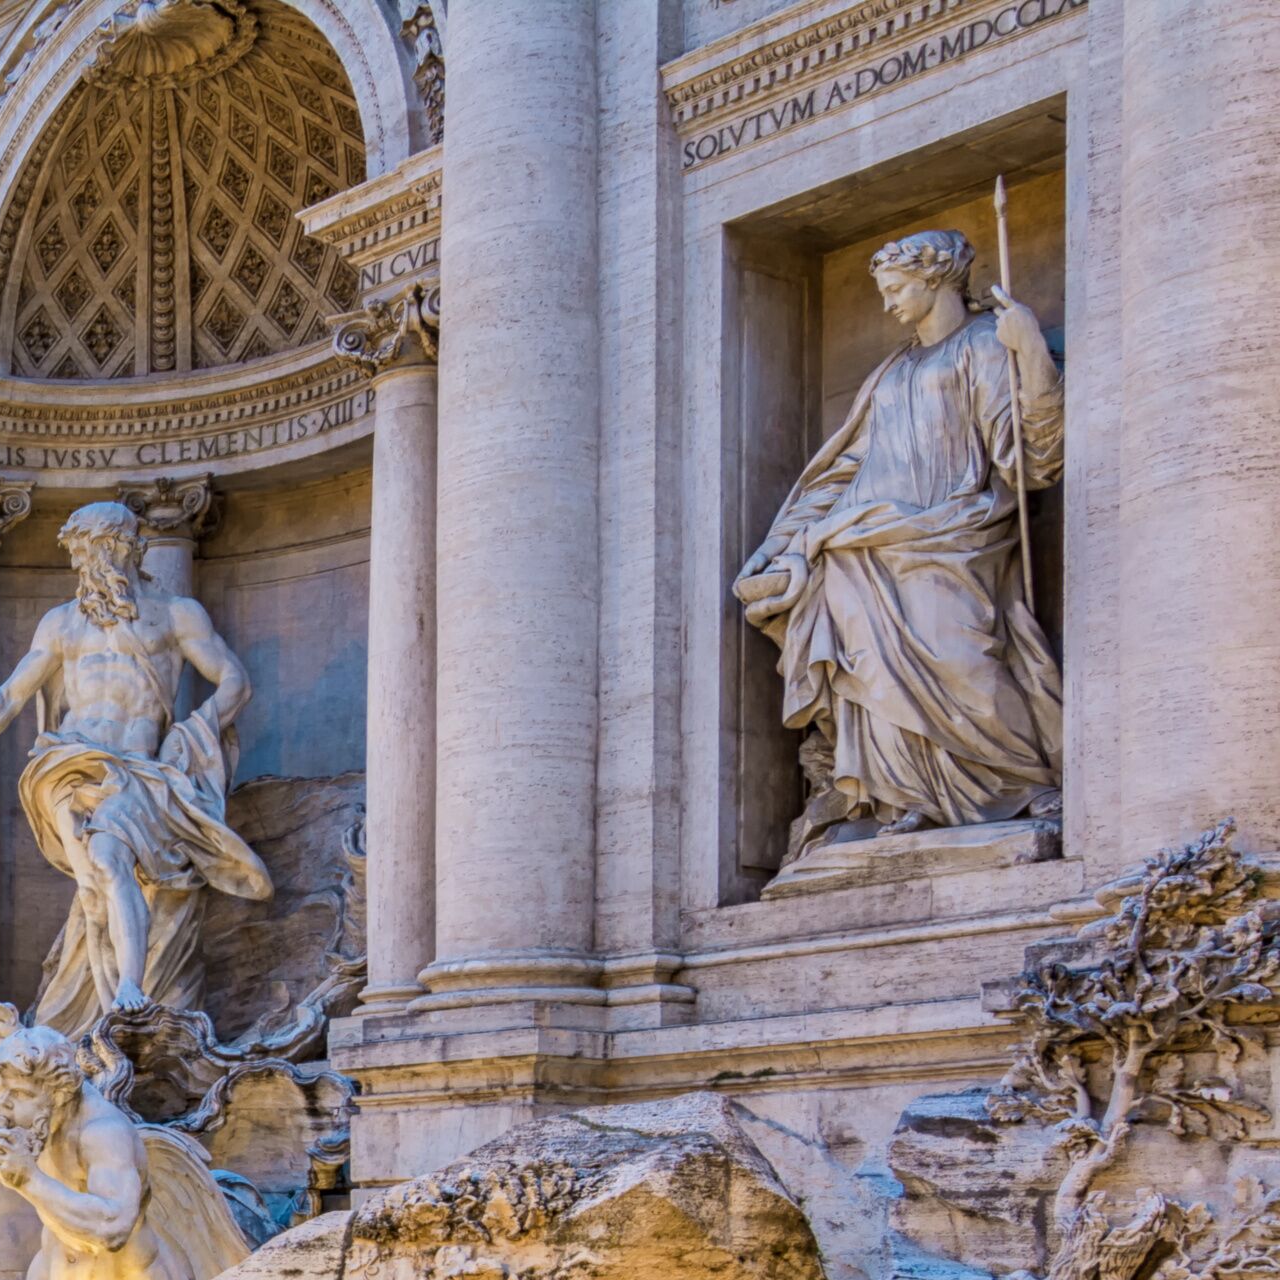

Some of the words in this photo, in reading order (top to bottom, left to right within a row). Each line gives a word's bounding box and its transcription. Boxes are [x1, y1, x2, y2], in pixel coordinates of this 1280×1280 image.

[683, 89, 817, 169] SOLVTVM
[360, 261, 383, 291] NI
[42, 448, 115, 469] IVSSV
[136, 414, 308, 466] CLEMENTIS
[318, 396, 355, 433] XIII
